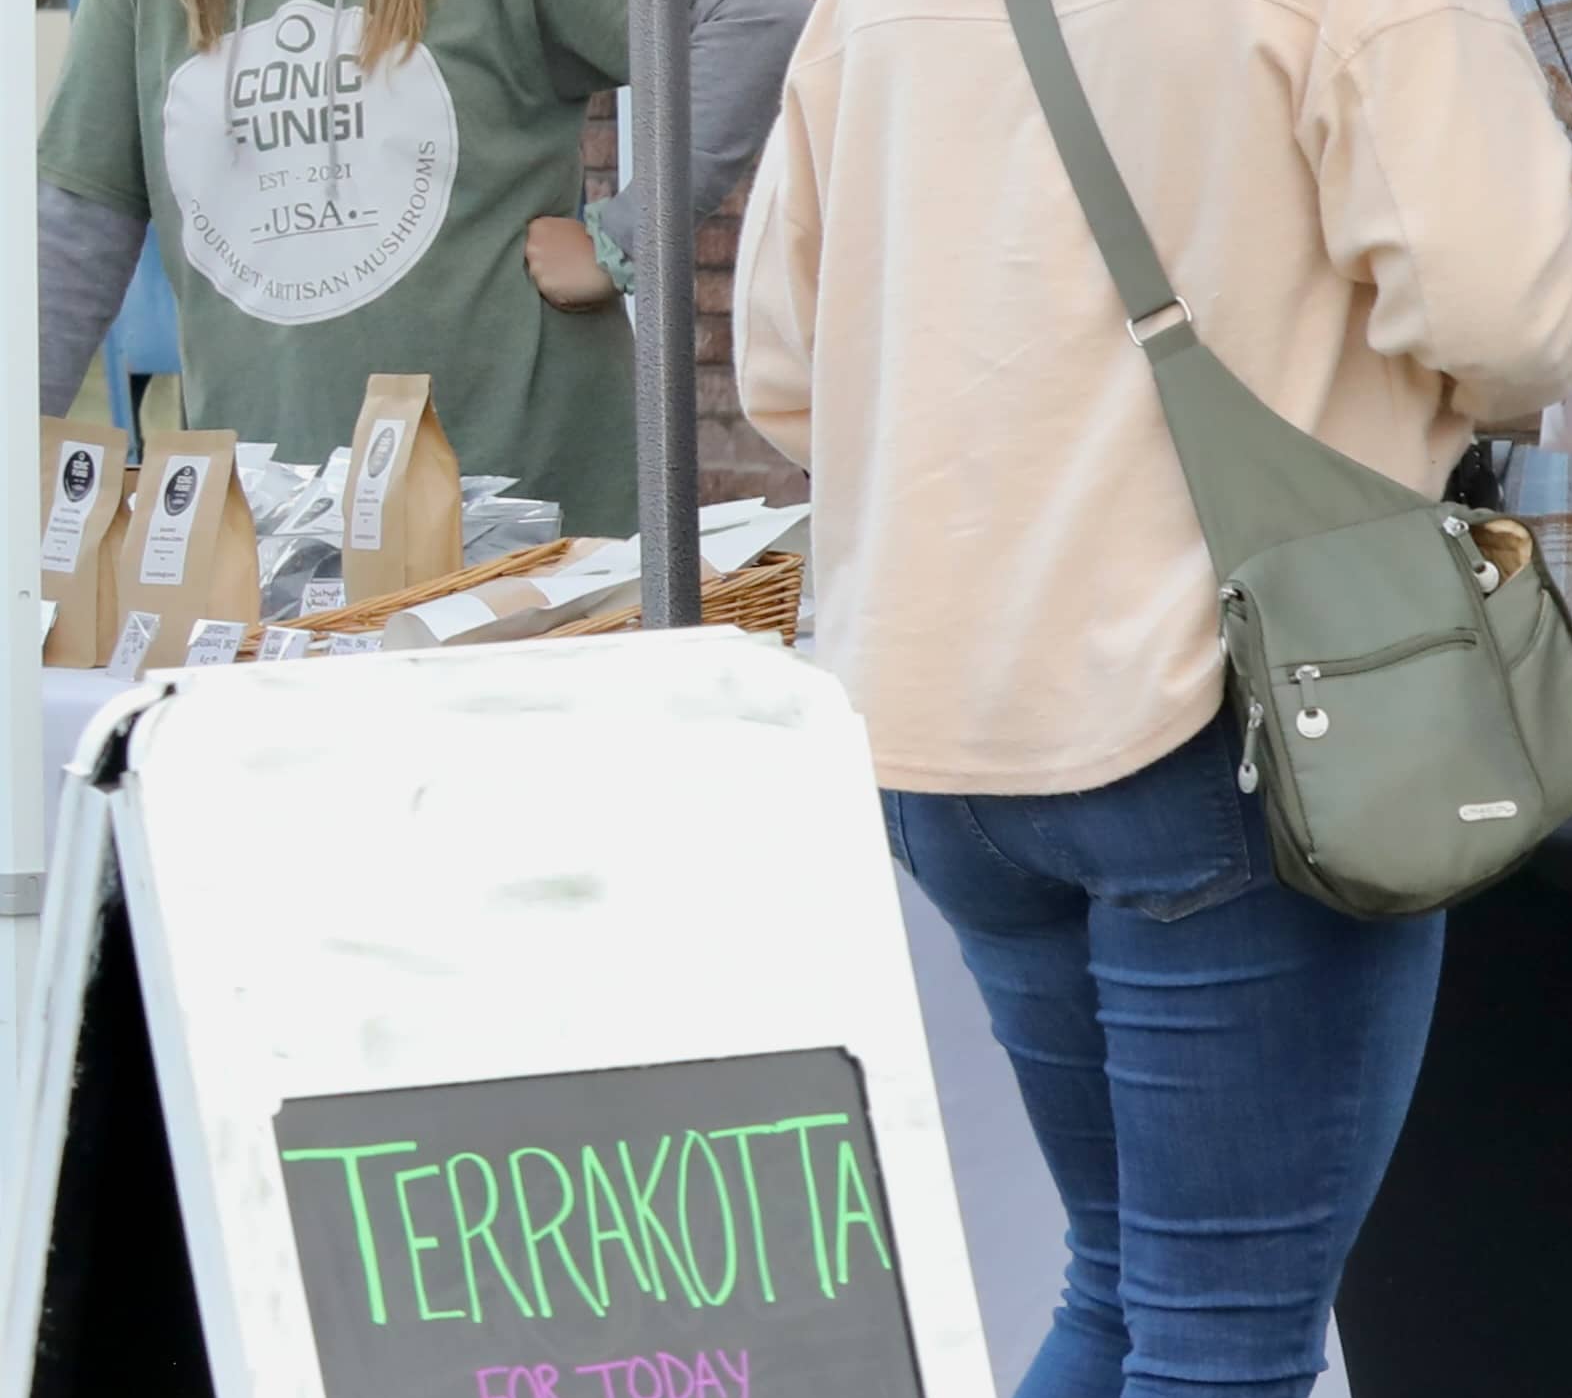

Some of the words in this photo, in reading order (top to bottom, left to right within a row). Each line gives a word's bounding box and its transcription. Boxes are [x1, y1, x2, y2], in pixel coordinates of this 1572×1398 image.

[259, 166, 290, 192] EST
[263, 272, 350, 301] ARTISAN
[353, 140, 436, 283] MUSHROOMS
[272, 200, 344, 235] USA
[282, 1113, 893, 1325] TERRAKOTTA
